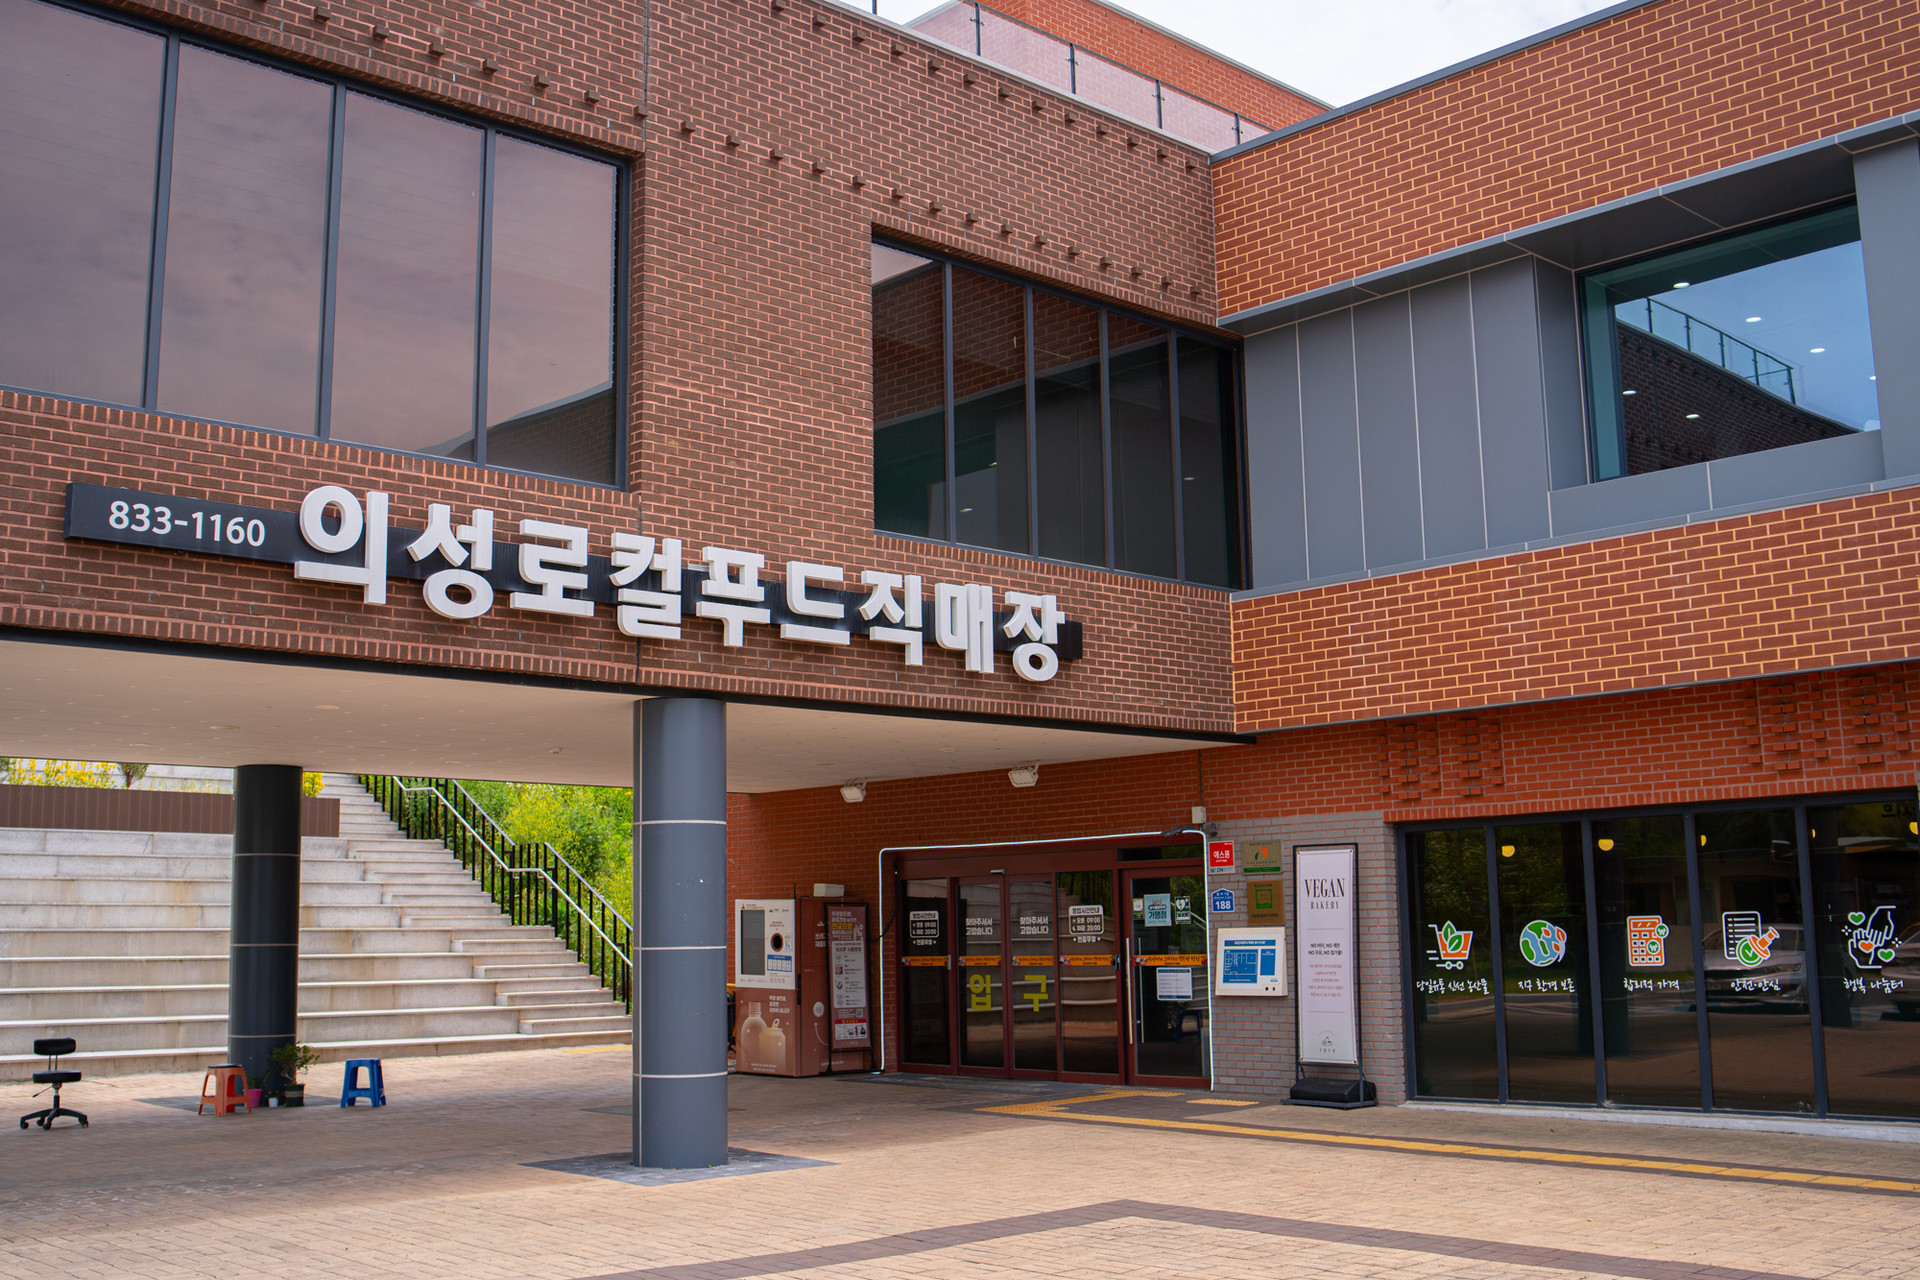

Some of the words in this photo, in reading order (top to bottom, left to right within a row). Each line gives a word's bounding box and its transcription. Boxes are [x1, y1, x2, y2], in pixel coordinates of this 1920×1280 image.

[109, 500, 266, 548] 833-1160
[294, 485, 1066, 682] 의성로컬푸드직매장
[1213, 850, 1230, 859] 에스원
[1304, 878, 1345, 898] VEGAN
[1215, 900, 1231, 910] 188
[1310, 901, 1339, 910] BAKERY
[912, 912, 936, 920] 영업시간안내
[1072, 907, 1100, 915] 영업시간안내
[1148, 910, 1167, 920] 가맹점
[966, 917, 993, 927] 찾아주셔서
[1020, 916, 1049, 926] 찾아주셔서
[966, 927, 993, 936] 고맙습니다
[1020, 926, 1049, 935] 고맙습니다
[1416, 977, 1446, 995] 당일유통
[1447, 980, 1465, 992] 신선
[1466, 977, 1490, 995] 농산물
[1517, 979, 1533, 992] 지구
[1536, 977, 1558, 992] 환경
[1560, 977, 1576, 993] 보존
[1623, 977, 1654, 992] 합리적
[1657, 978, 1680, 990] 가격
[1843, 976, 1867, 995] 행복
[1870, 977, 1904, 994] 나눔터
[969, 974, 992, 1011] 입
[1023, 974, 1049, 1012] 구
